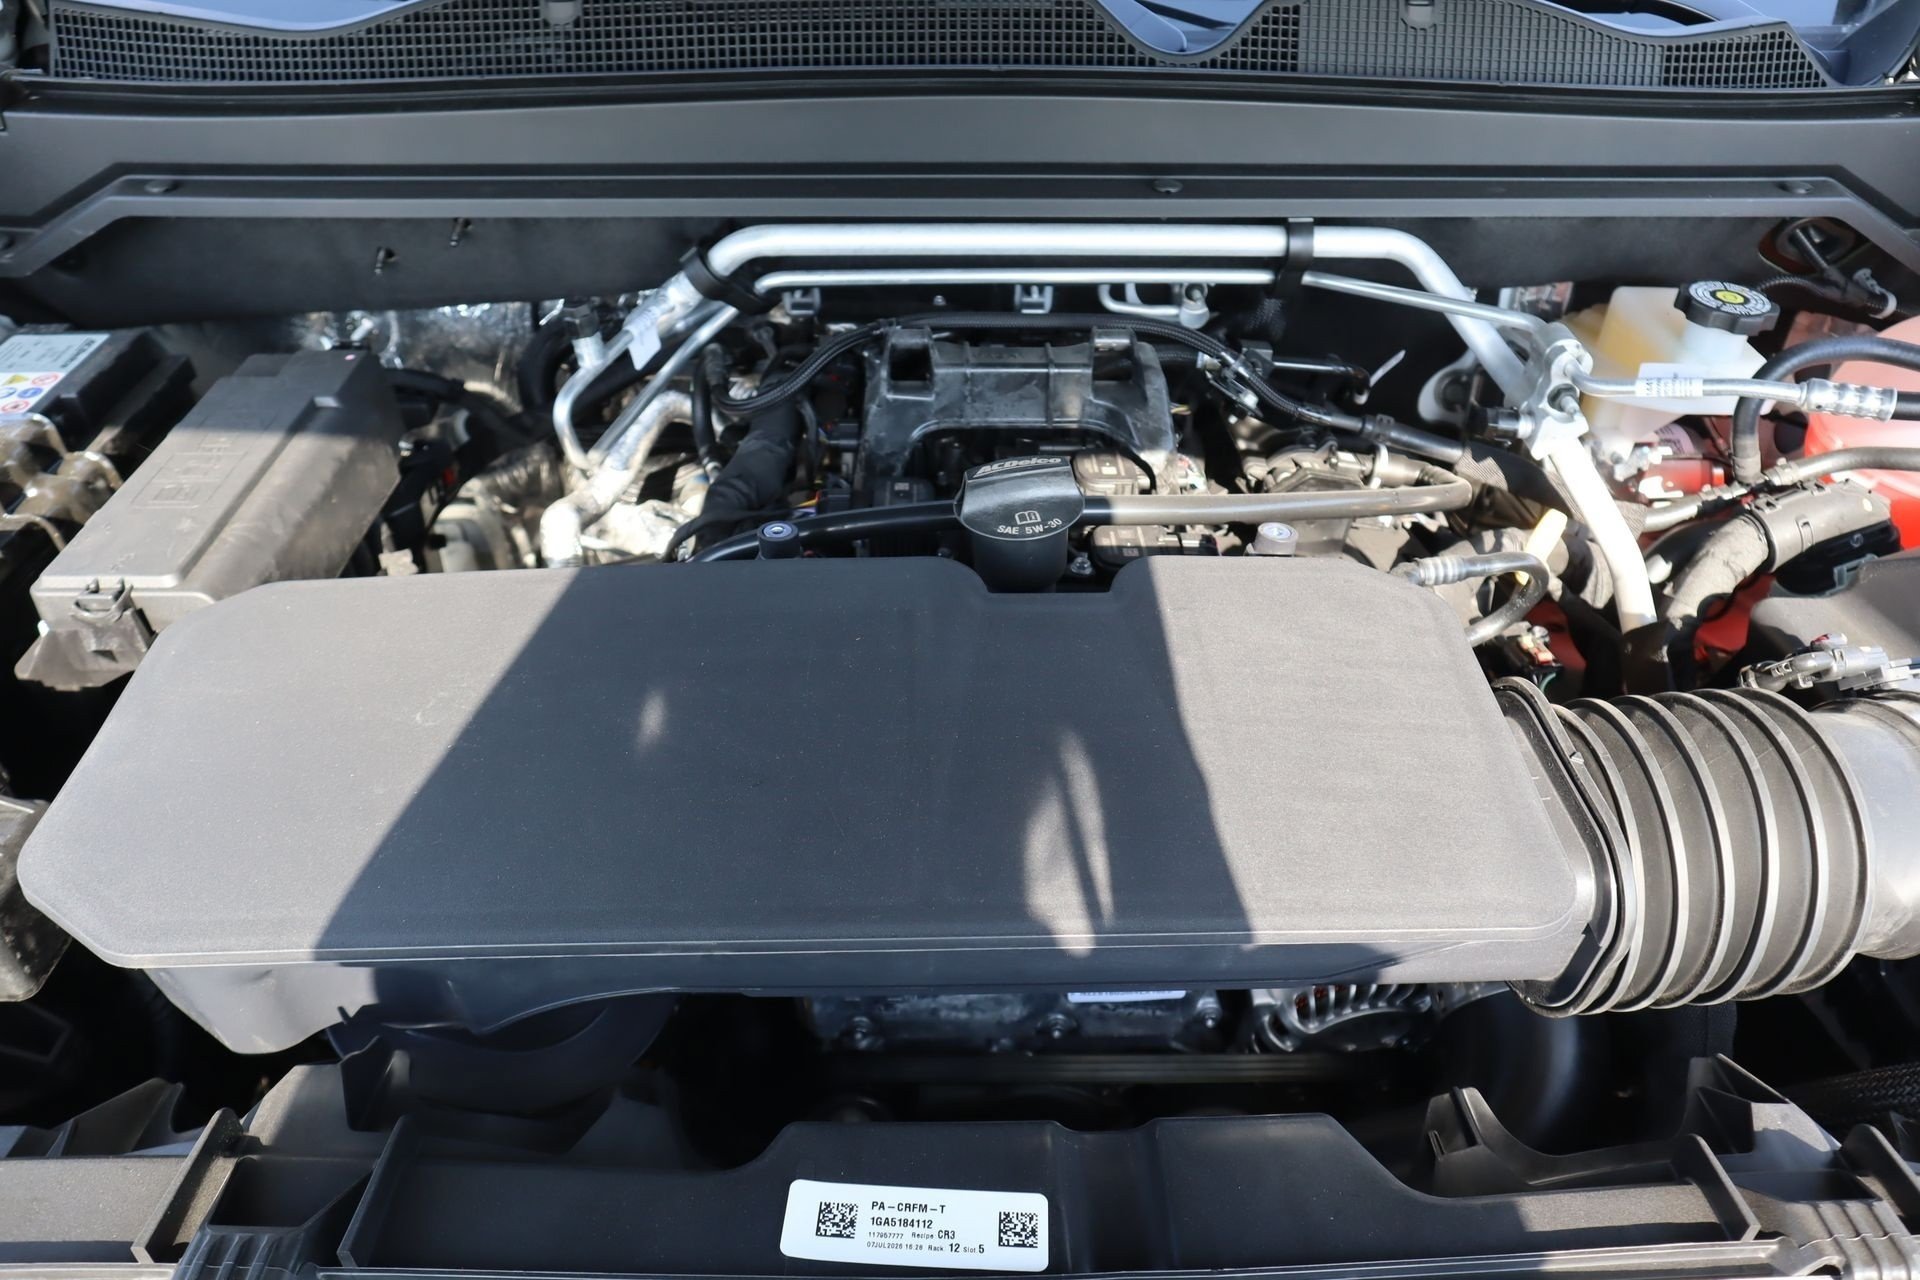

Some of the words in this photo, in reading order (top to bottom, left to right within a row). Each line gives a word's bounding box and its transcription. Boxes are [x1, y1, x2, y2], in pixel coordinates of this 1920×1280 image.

[973, 457, 1062, 478] ACDelco
[996, 524, 1020, 535] SAE
[1025, 518, 1063, 535] 5W-30
[871, 1201, 946, 1214] PA-CRFM-T
[870, 1216, 934, 1229] 1GA5184112
[937, 1229, 956, 1240] CR3
[949, 1242, 961, 1253] 12
[978, 1243, 985, 1254] 5
